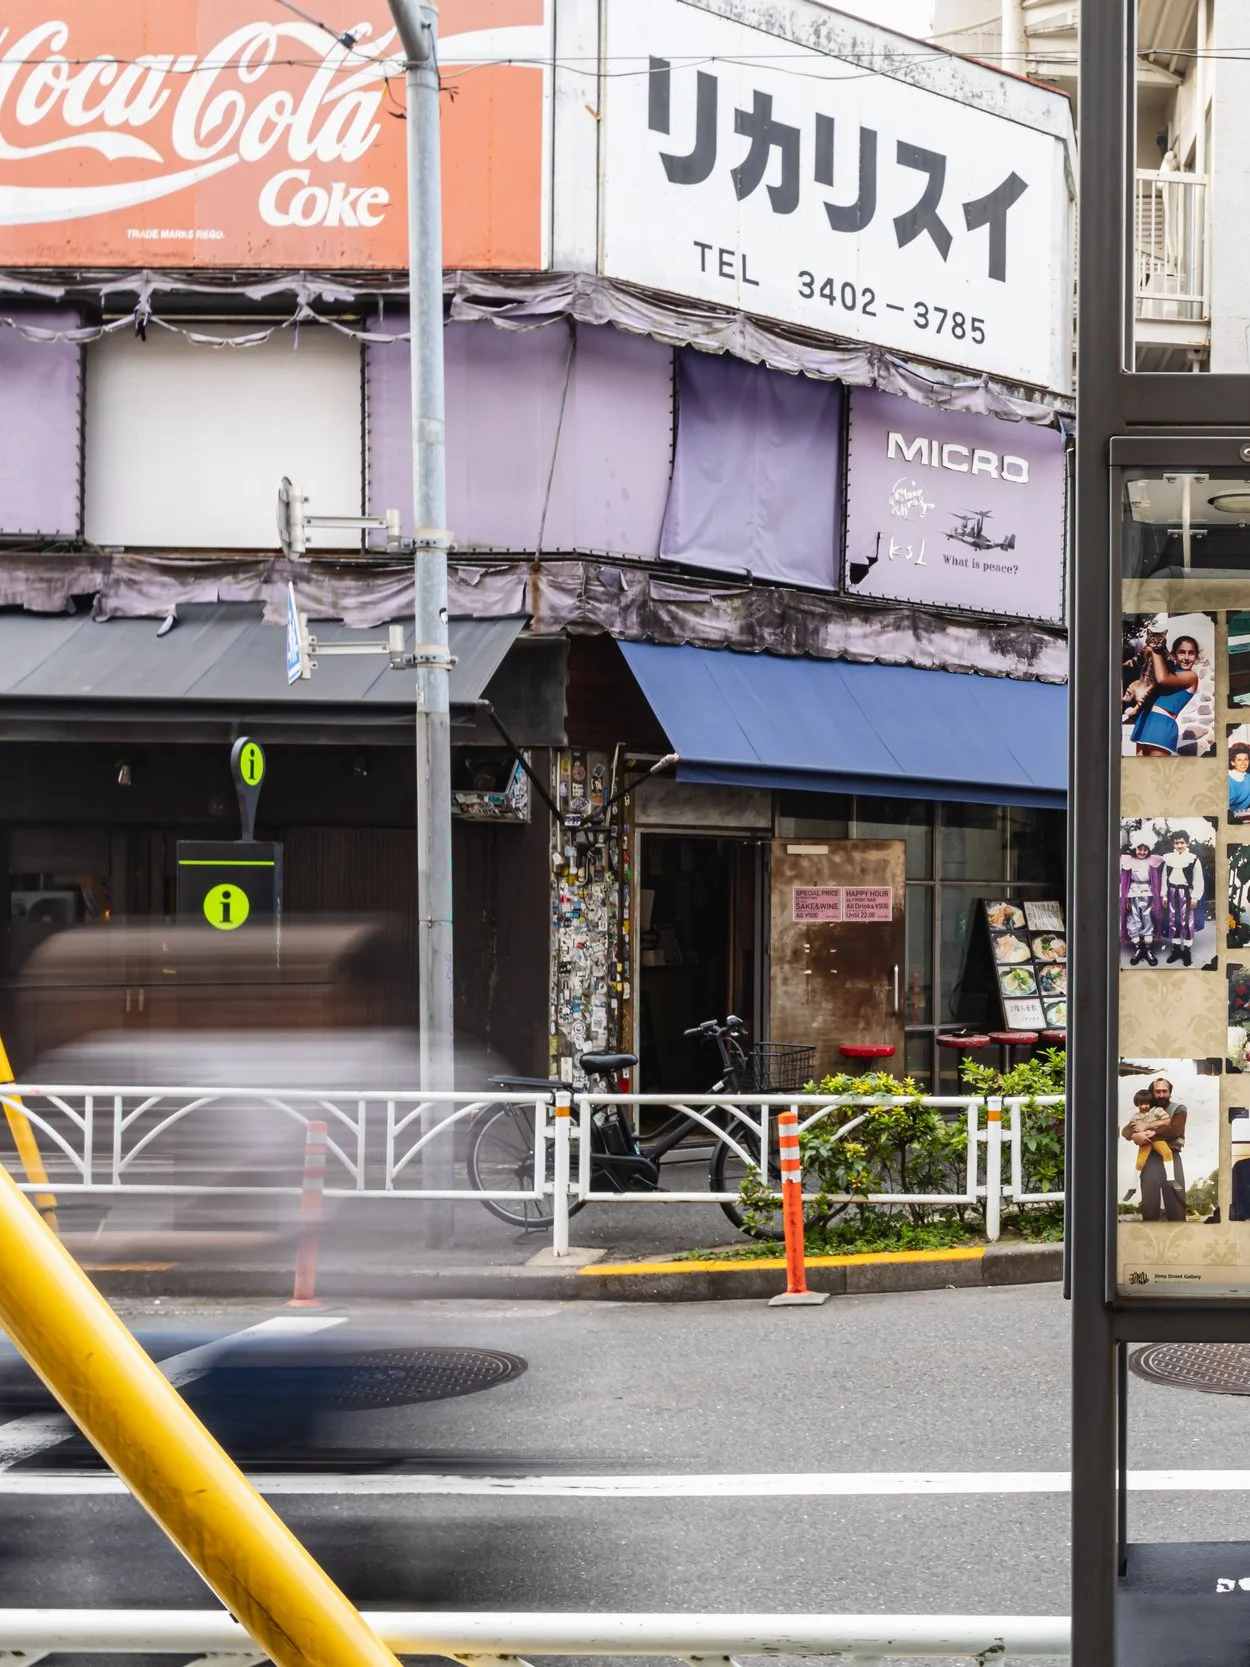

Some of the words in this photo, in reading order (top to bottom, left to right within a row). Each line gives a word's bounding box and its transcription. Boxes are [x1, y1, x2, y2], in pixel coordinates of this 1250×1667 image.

[648, 54, 1029, 284] リカリスイ
[258, 168, 390, 228] Coke
[127, 229, 159, 240] TRADE
[693, 240, 760, 287] TEL
[887, 431, 1030, 484] MICRO
[943, 553, 969, 568] What
[971, 557, 981, 570] is
[982, 561, 1020, 575] peace?
